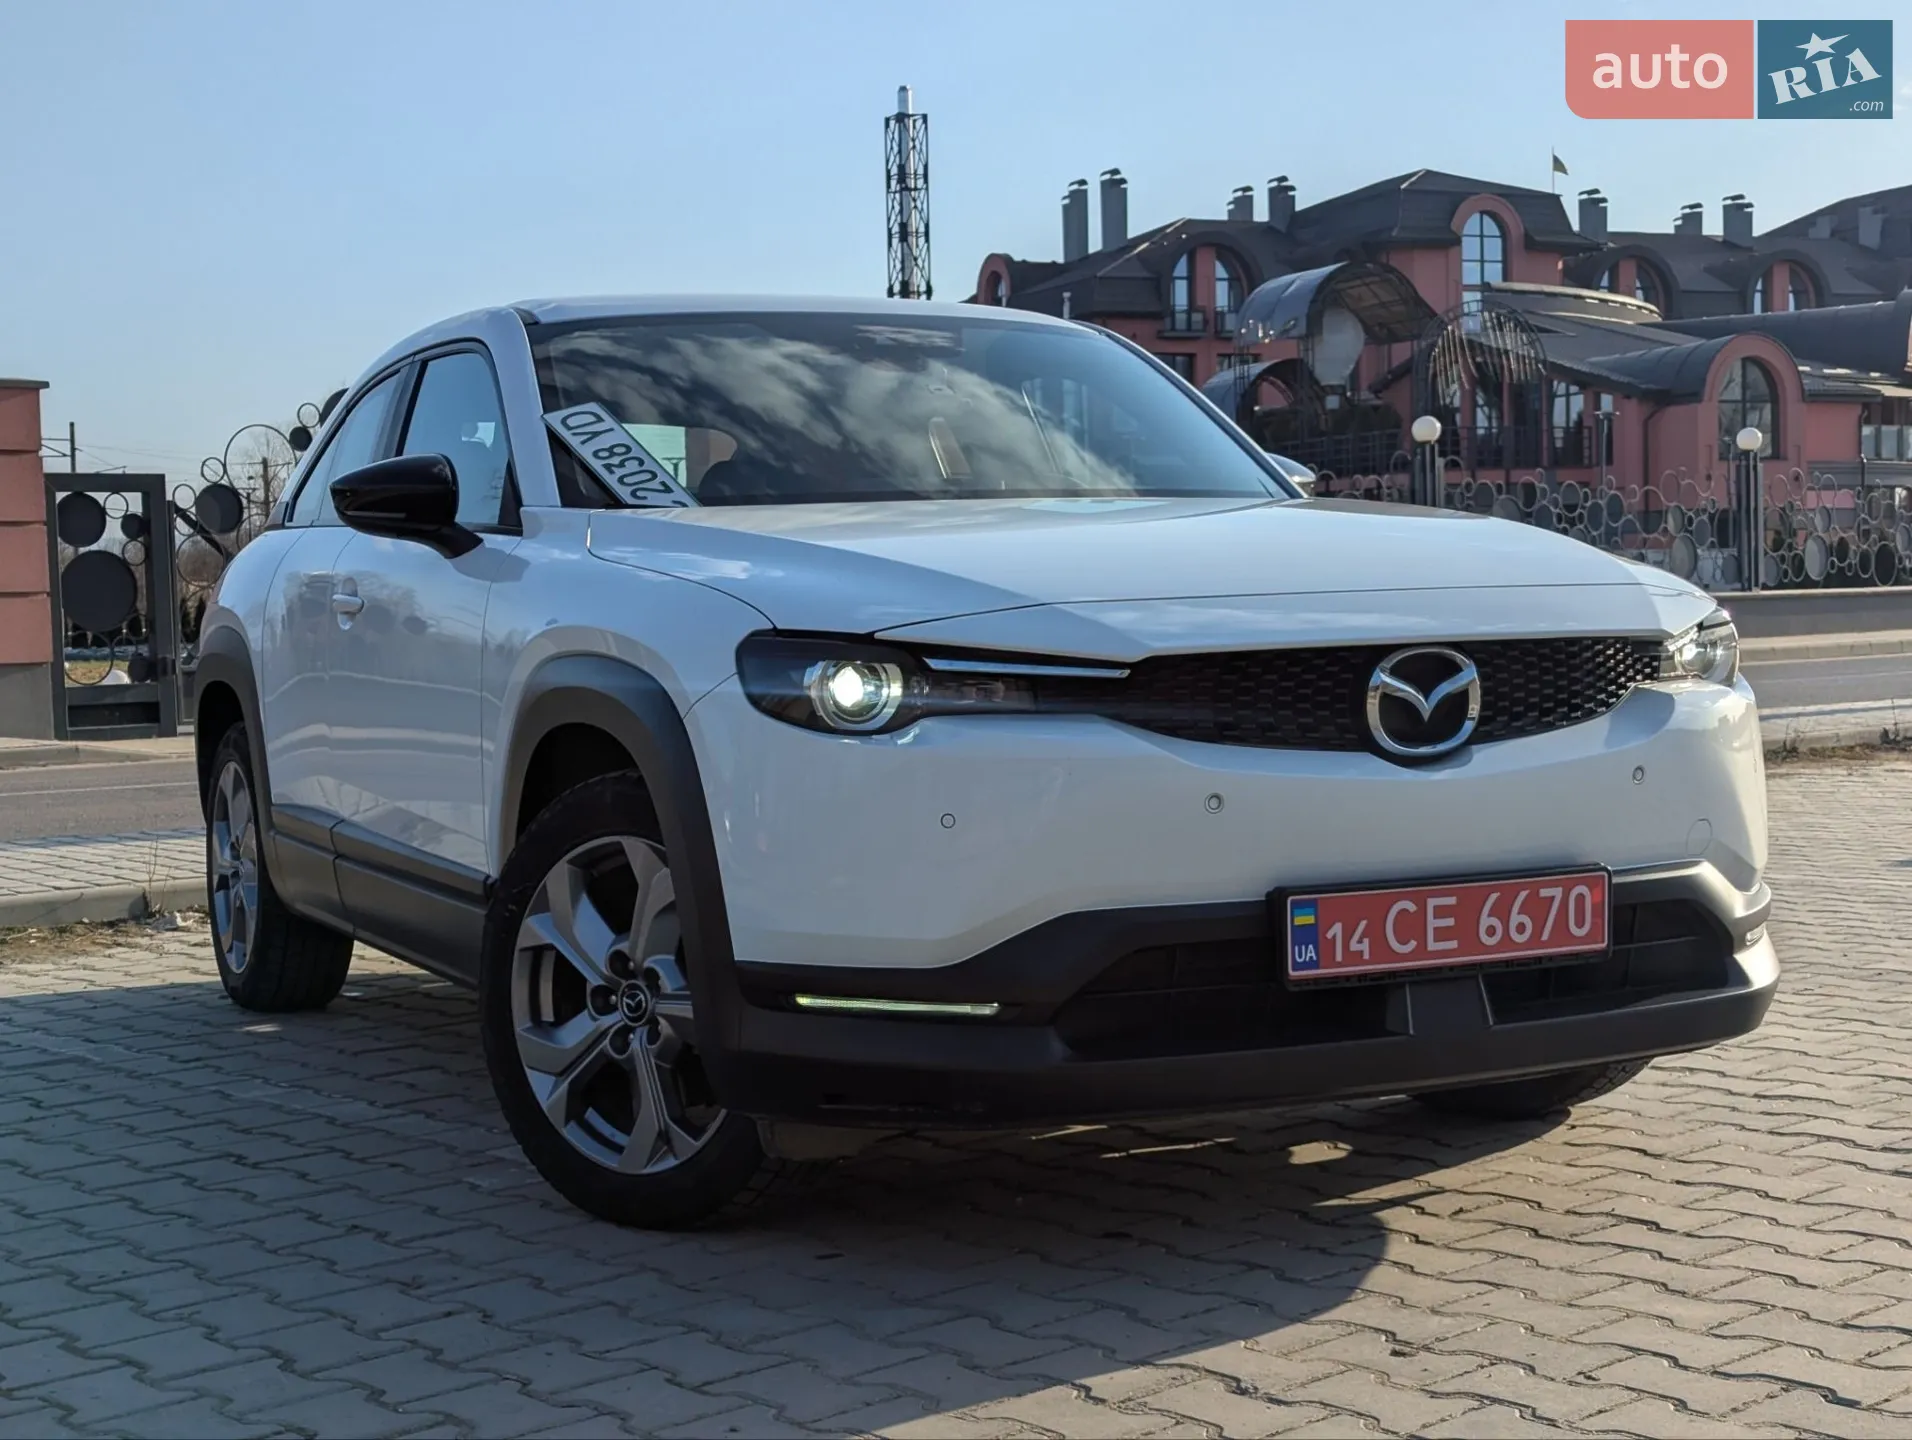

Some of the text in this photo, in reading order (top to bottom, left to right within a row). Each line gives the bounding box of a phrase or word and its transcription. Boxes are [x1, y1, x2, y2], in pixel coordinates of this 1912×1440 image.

[1325, 884, 1592, 962] 14 CE 6670
[1294, 944, 1317, 963] UA
